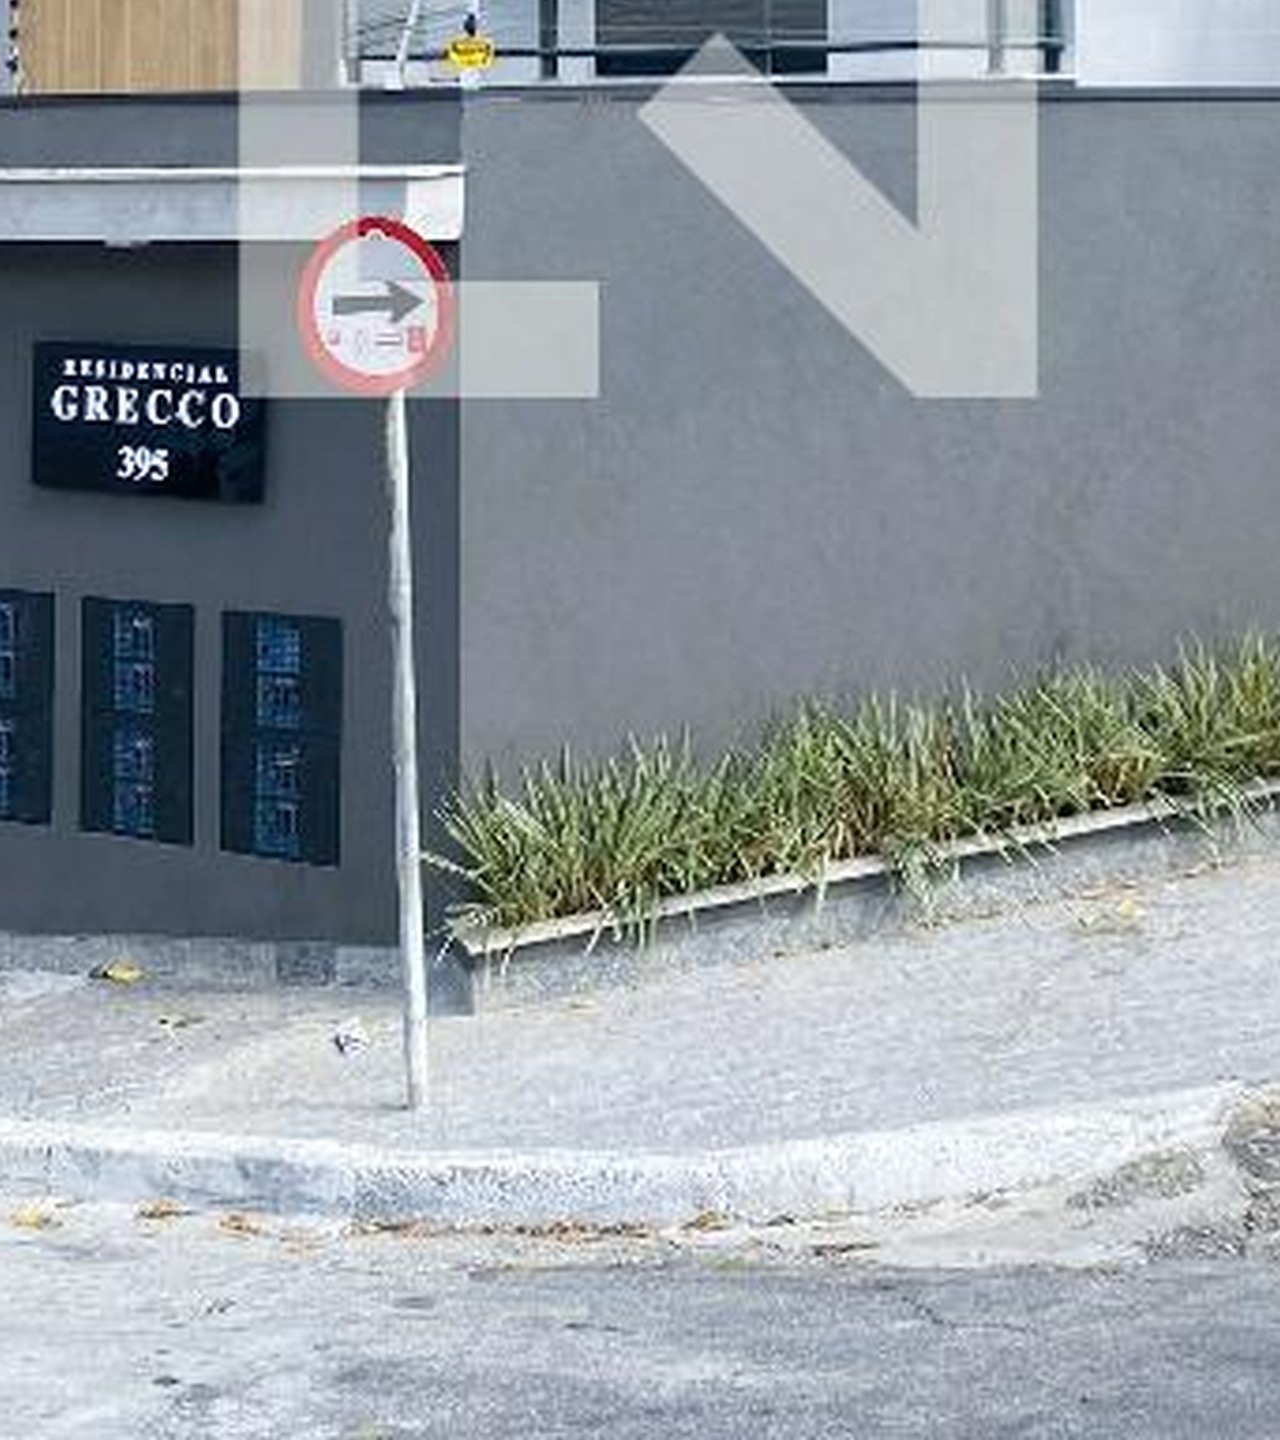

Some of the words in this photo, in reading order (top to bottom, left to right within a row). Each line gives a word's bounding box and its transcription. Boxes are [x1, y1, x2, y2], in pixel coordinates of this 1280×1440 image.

[62, 359, 229, 384] RESIDENCIAL
[50, 385, 240, 429] GRECCO
[117, 445, 169, 481] 395
